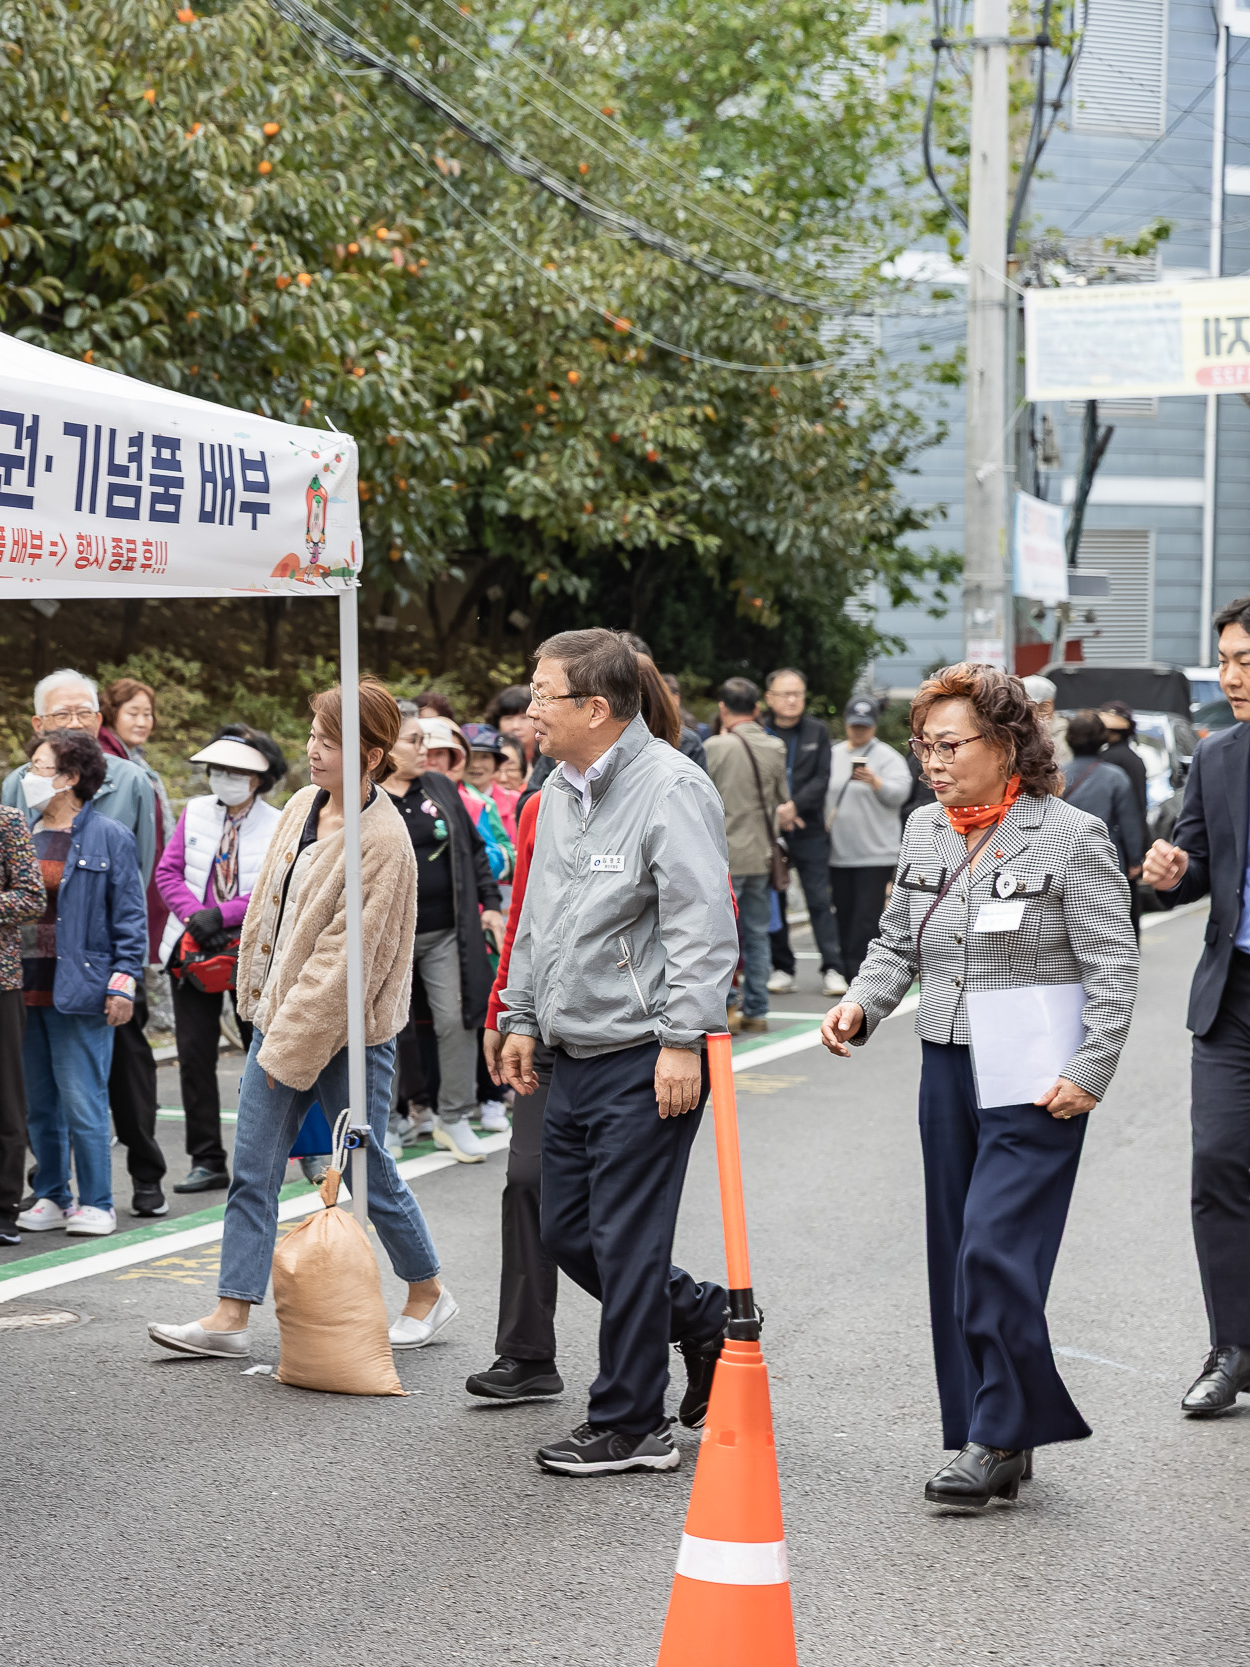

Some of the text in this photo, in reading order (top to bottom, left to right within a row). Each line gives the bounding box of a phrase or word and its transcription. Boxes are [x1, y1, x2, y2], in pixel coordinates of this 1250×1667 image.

[198, 442, 271, 531] 배부
[8, 527, 43, 566] 배부
[75, 532, 107, 569] 행사
[108, 537, 137, 571] 종료
[139, 539, 168, 574] 후!!!
